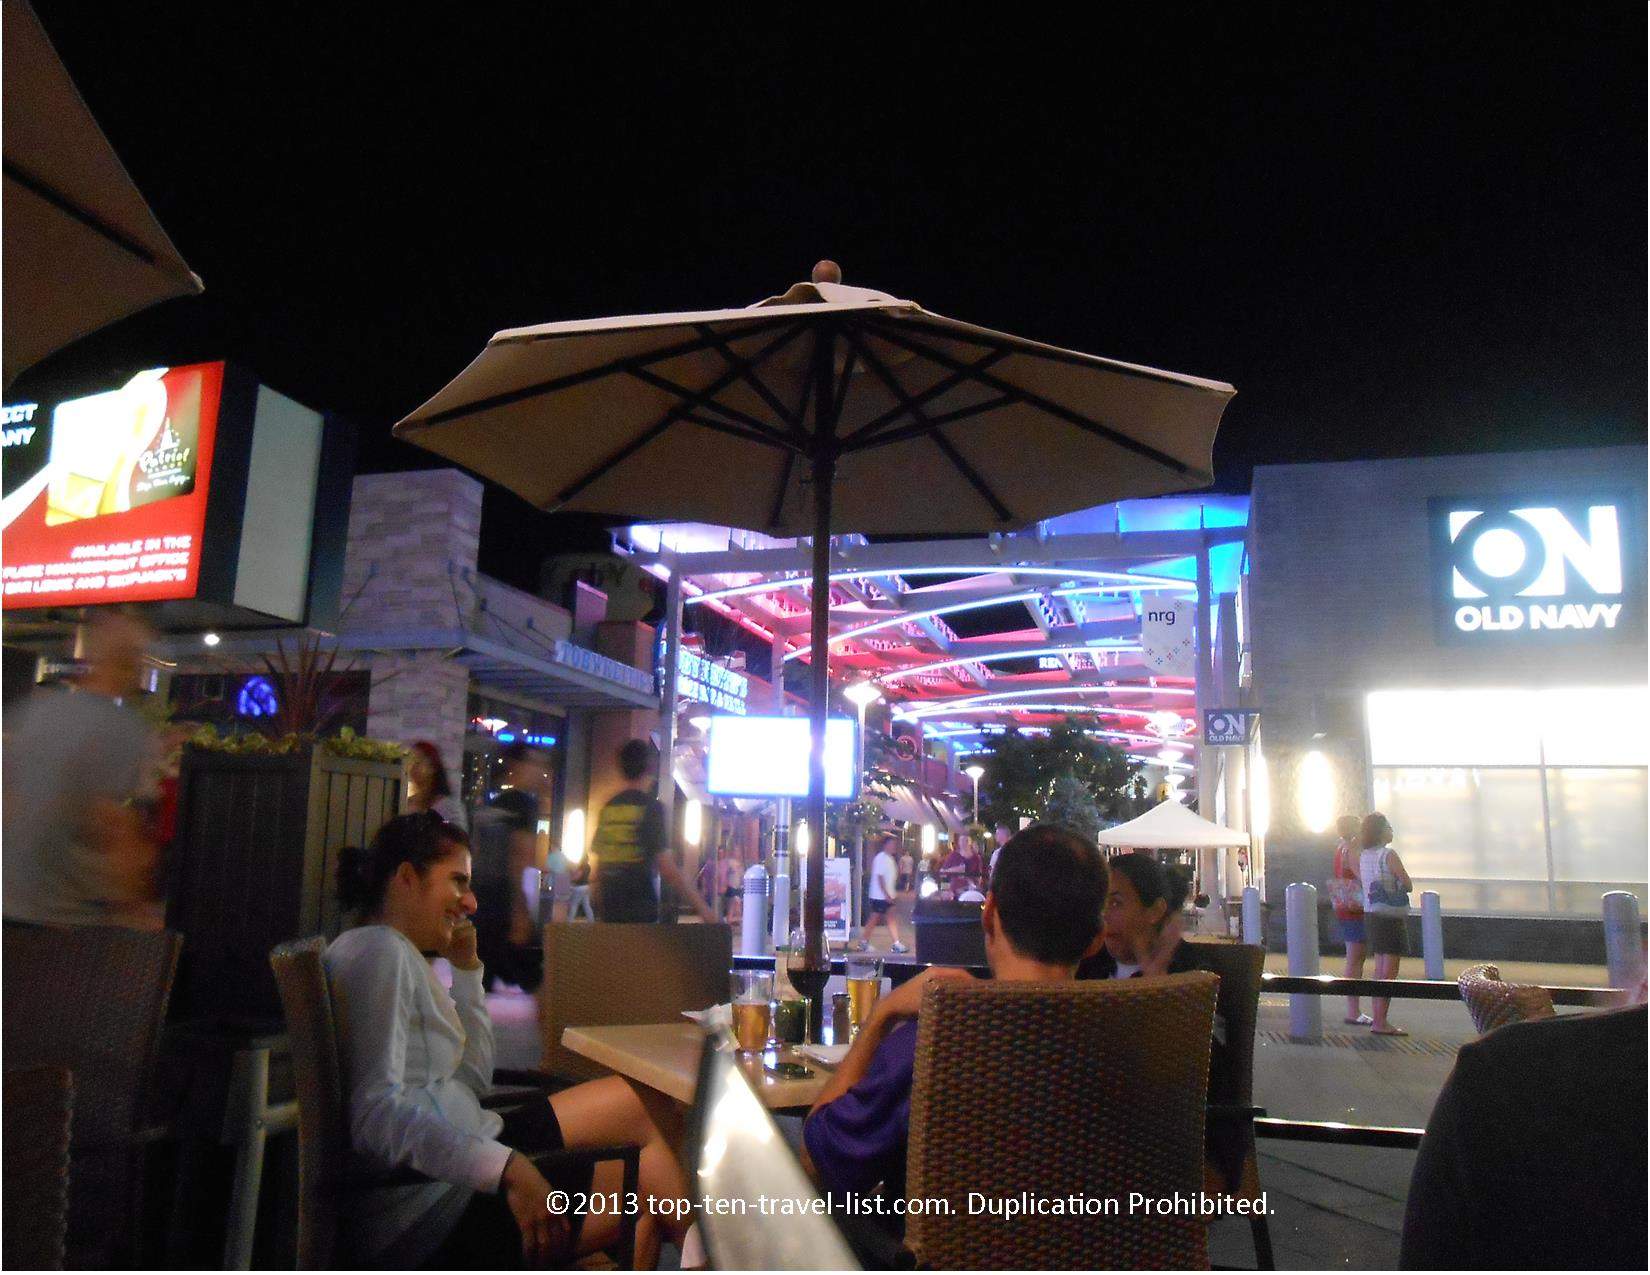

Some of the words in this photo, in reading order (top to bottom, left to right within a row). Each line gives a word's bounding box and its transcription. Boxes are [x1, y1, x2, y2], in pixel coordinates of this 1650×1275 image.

[144, 538, 162, 551] IN
[1449, 505, 1623, 599] ON
[1148, 610, 1176, 625] nrg
[1454, 605, 1524, 632] OLD
[1529, 603, 1623, 630] NAVY
